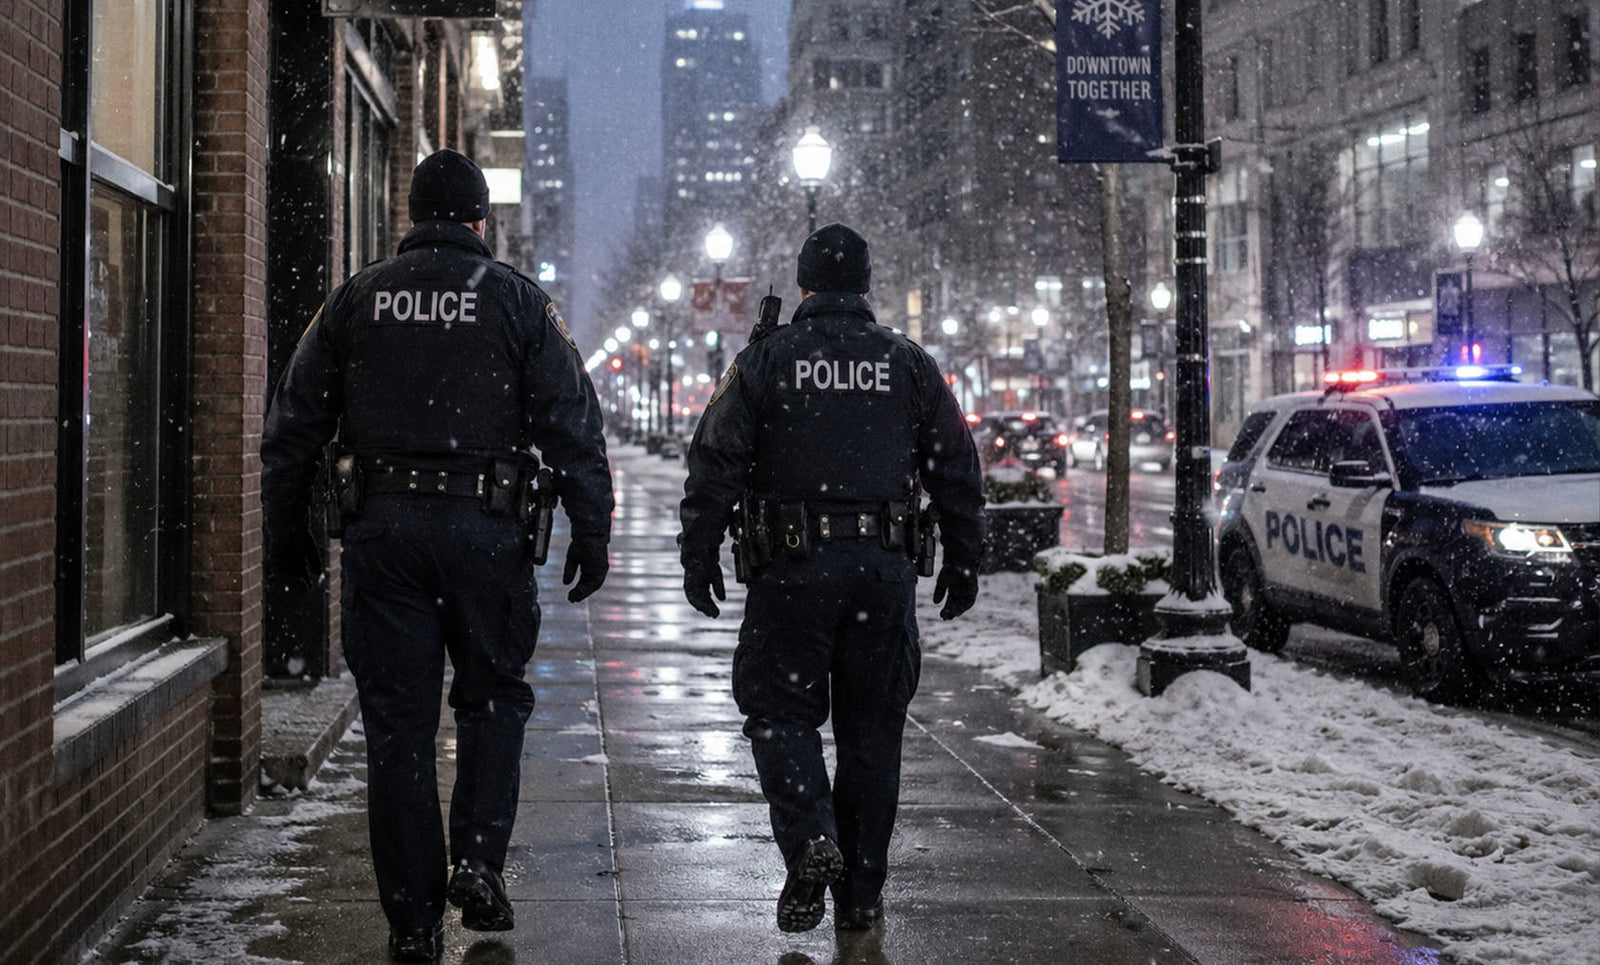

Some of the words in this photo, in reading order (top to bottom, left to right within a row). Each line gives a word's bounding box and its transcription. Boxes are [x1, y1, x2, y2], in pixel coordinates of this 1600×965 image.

[1067, 56, 1151, 75] DOWNTOWN
[1067, 80, 1152, 99] TOGETHER
[373, 290, 478, 322] POLICE
[795, 359, 890, 392] POLICE
[1265, 510, 1366, 574] POLICE
